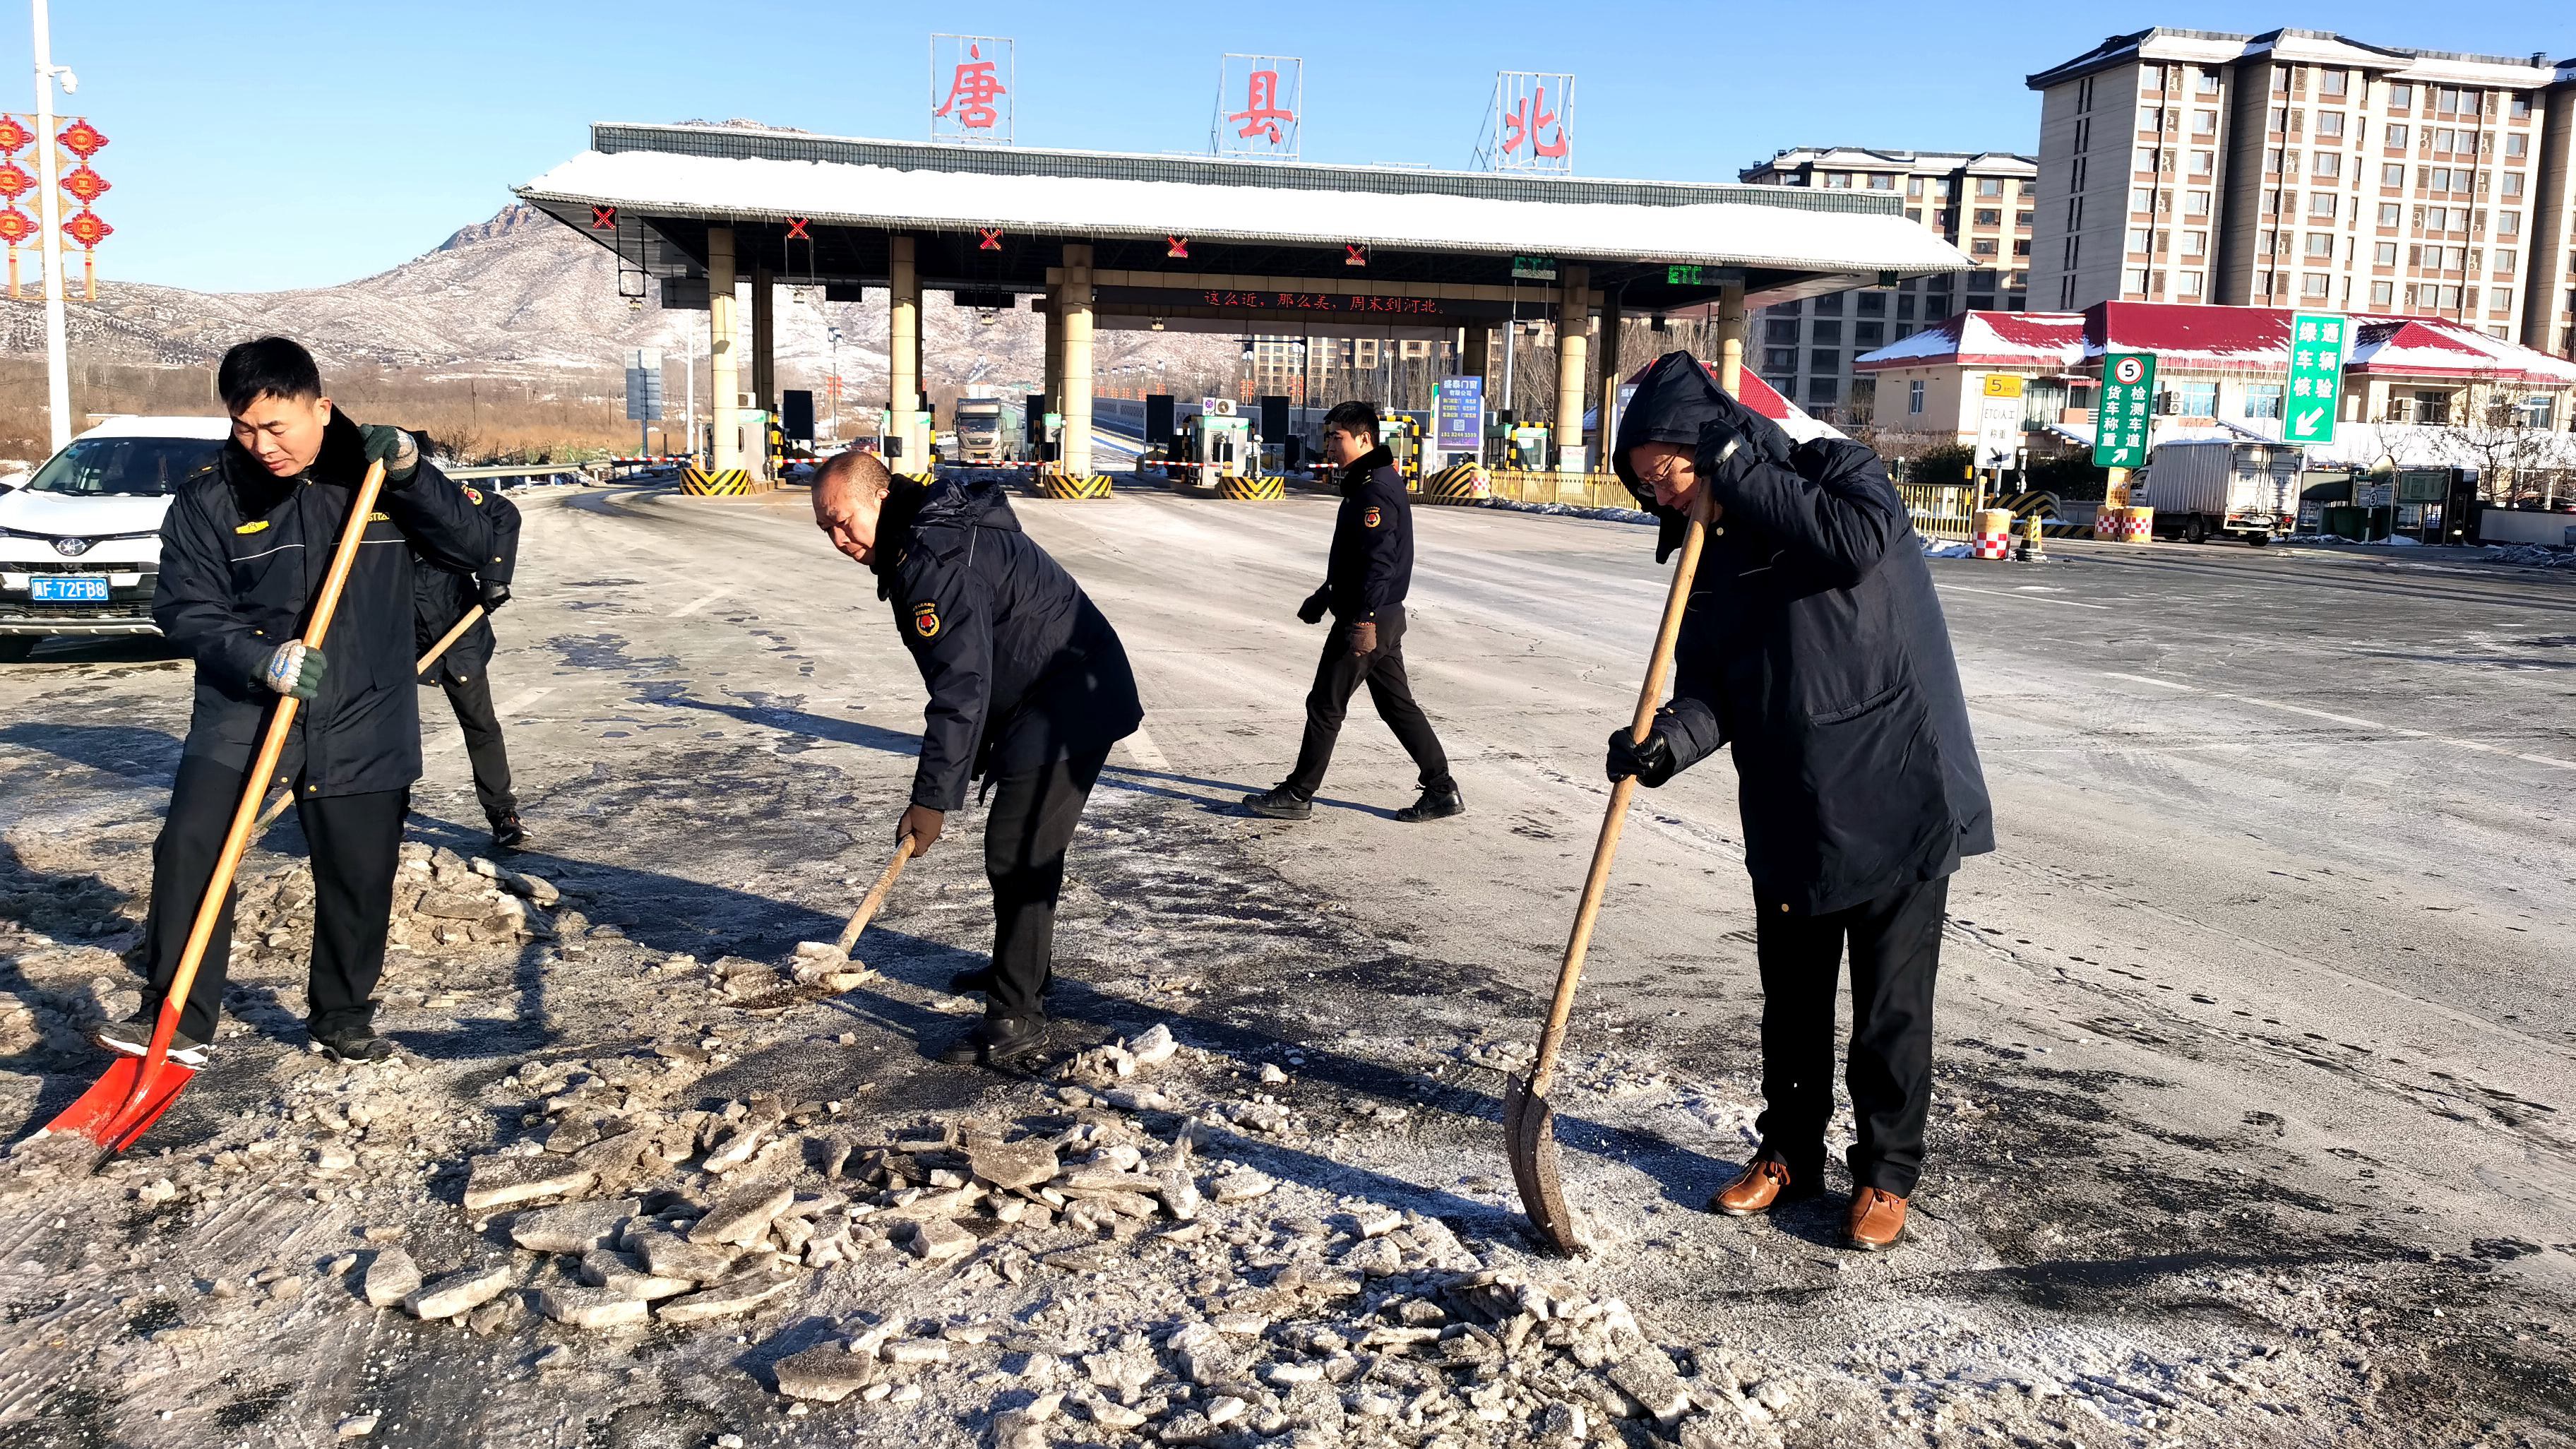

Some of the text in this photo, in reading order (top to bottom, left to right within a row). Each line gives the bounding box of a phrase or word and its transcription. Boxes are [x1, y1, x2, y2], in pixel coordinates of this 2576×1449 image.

[936, 43, 1568, 157] 唐县北
[1669, 266, 1703, 285] ETC
[2298, 322, 2340, 343] 绿通
[2125, 364, 2135, 377] 5
[2296, 350, 2337, 371] 车辆
[1991, 379, 2001, 391] 5
[2293, 376, 2334, 398] 核验
[2101, 385, 2123, 447] 货车称重
[2125, 386, 2147, 448] 检测车道
